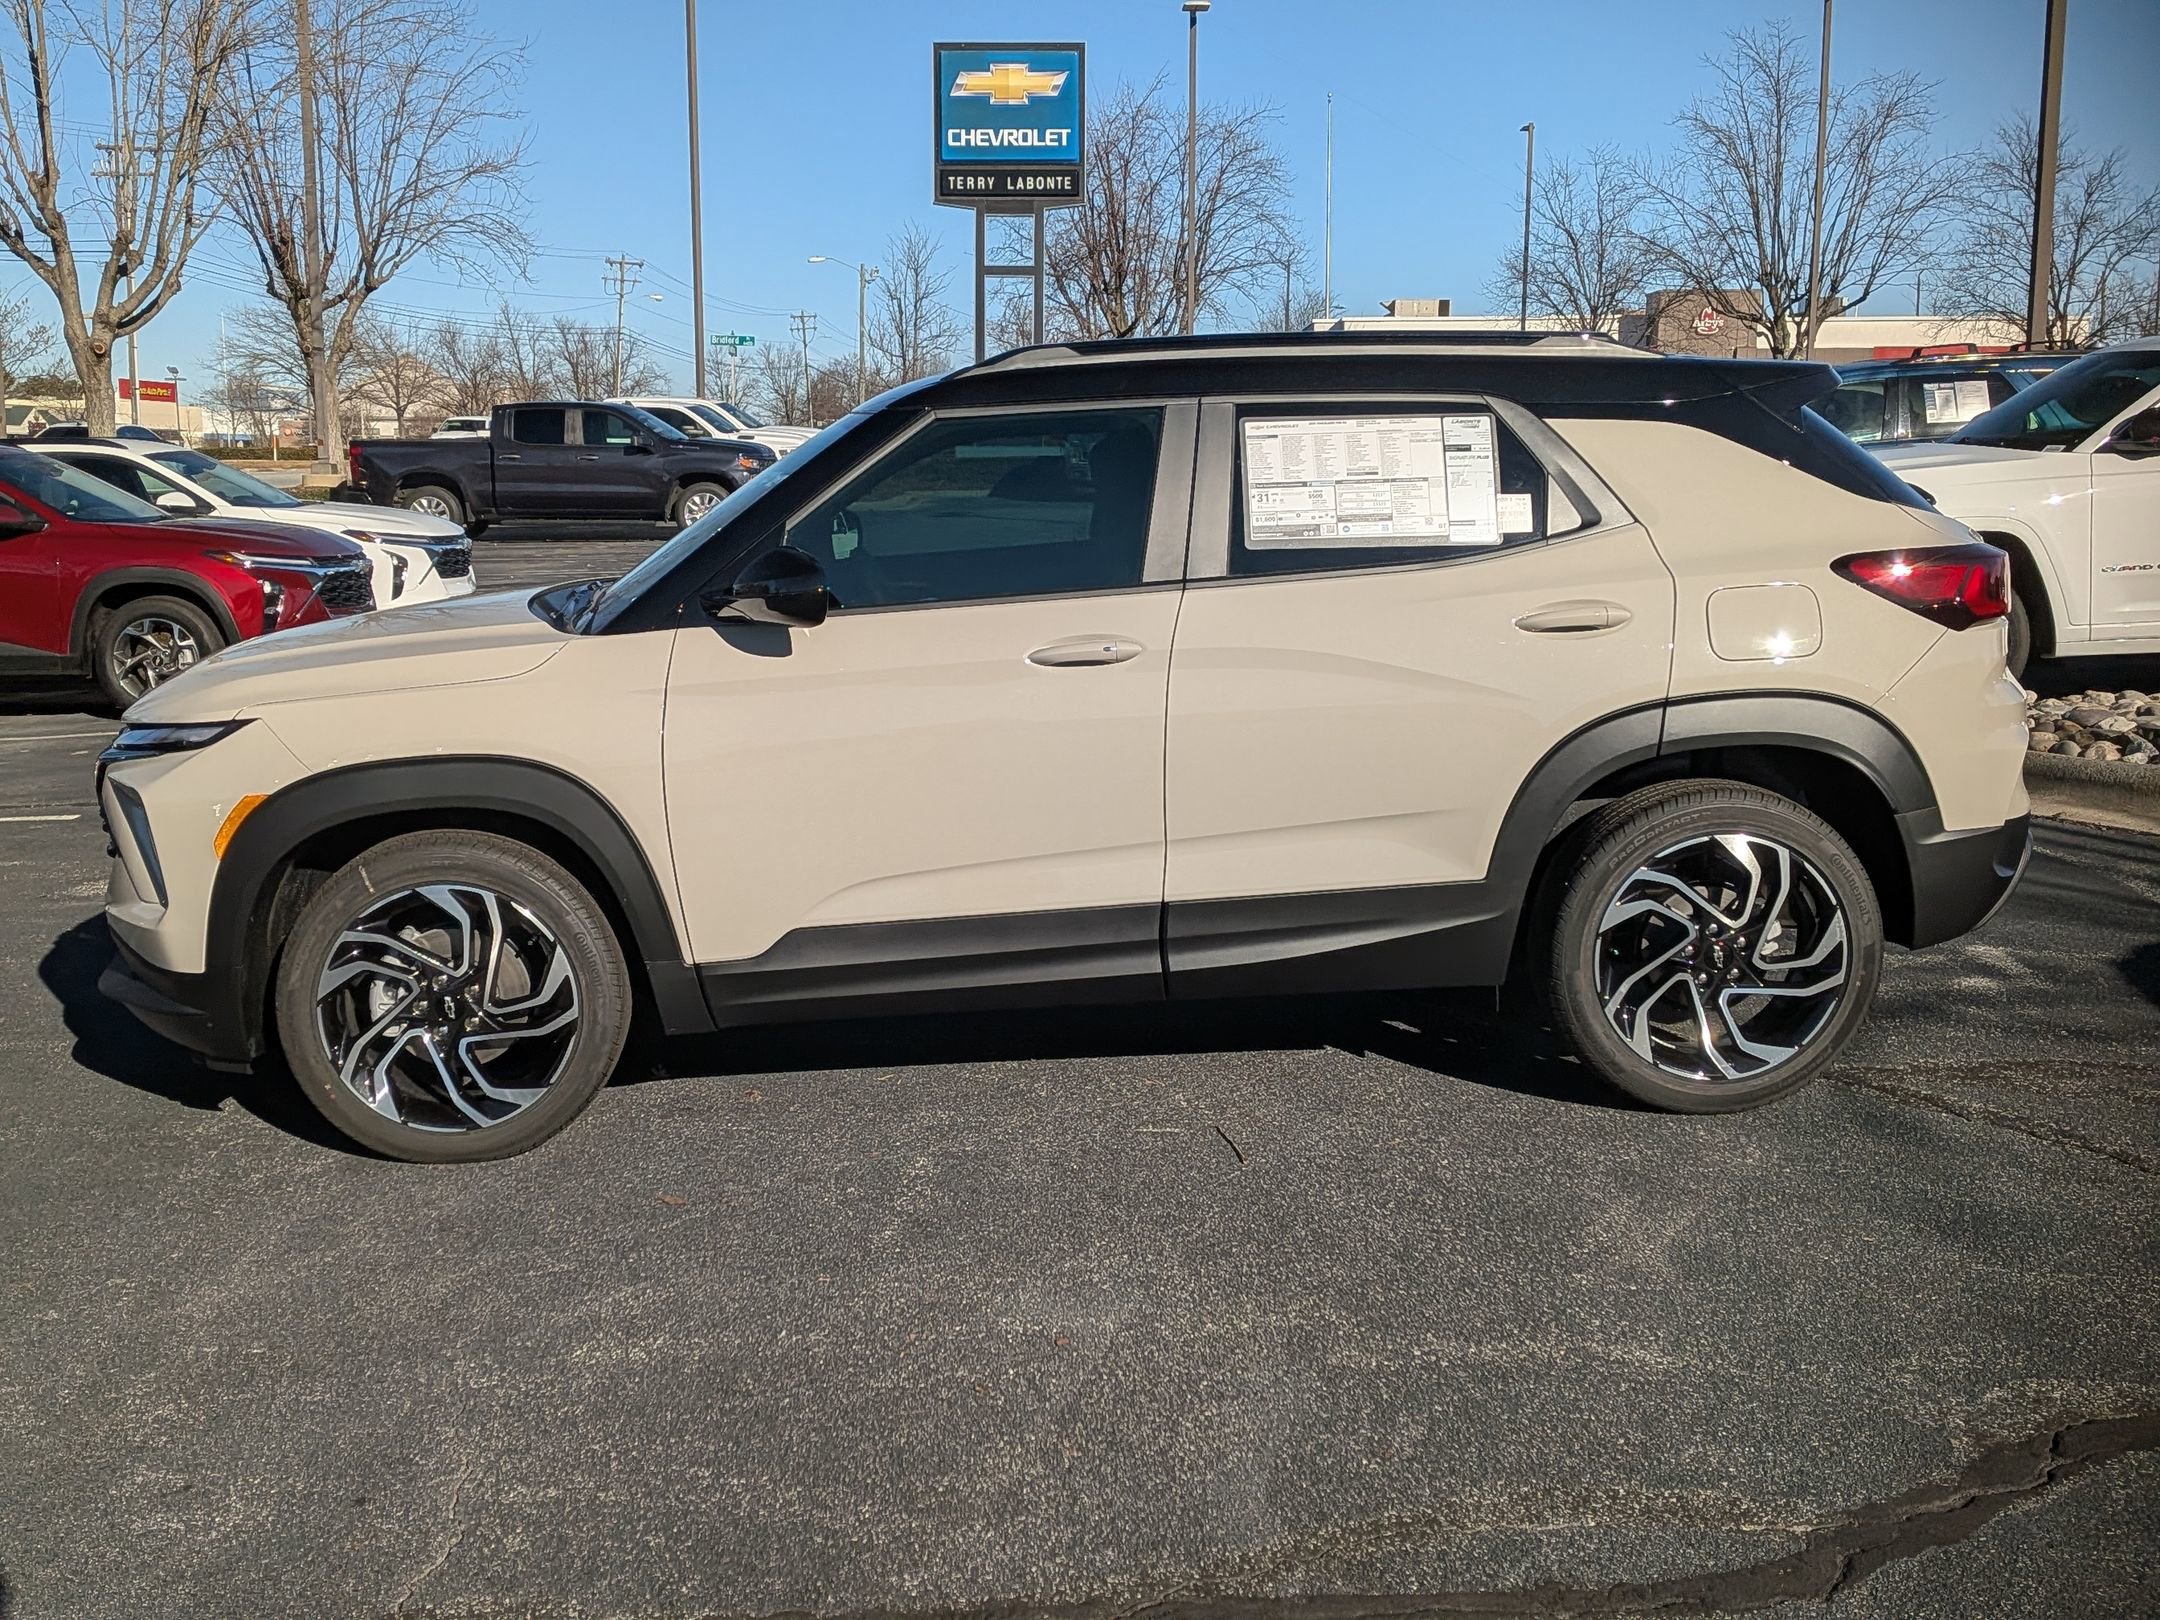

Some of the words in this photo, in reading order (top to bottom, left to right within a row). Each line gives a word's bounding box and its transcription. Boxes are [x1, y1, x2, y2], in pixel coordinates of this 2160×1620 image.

[947, 128, 1071, 147] CHEVROLET
[948, 176, 995, 190] TERRY
[1007, 175, 1072, 190] LABONTE
[1692, 317, 1724, 329] Arby's
[711, 335, 740, 345] Bridford
[1257, 493, 1270, 503] 31
[1831, 853, 1871, 917] Continental
